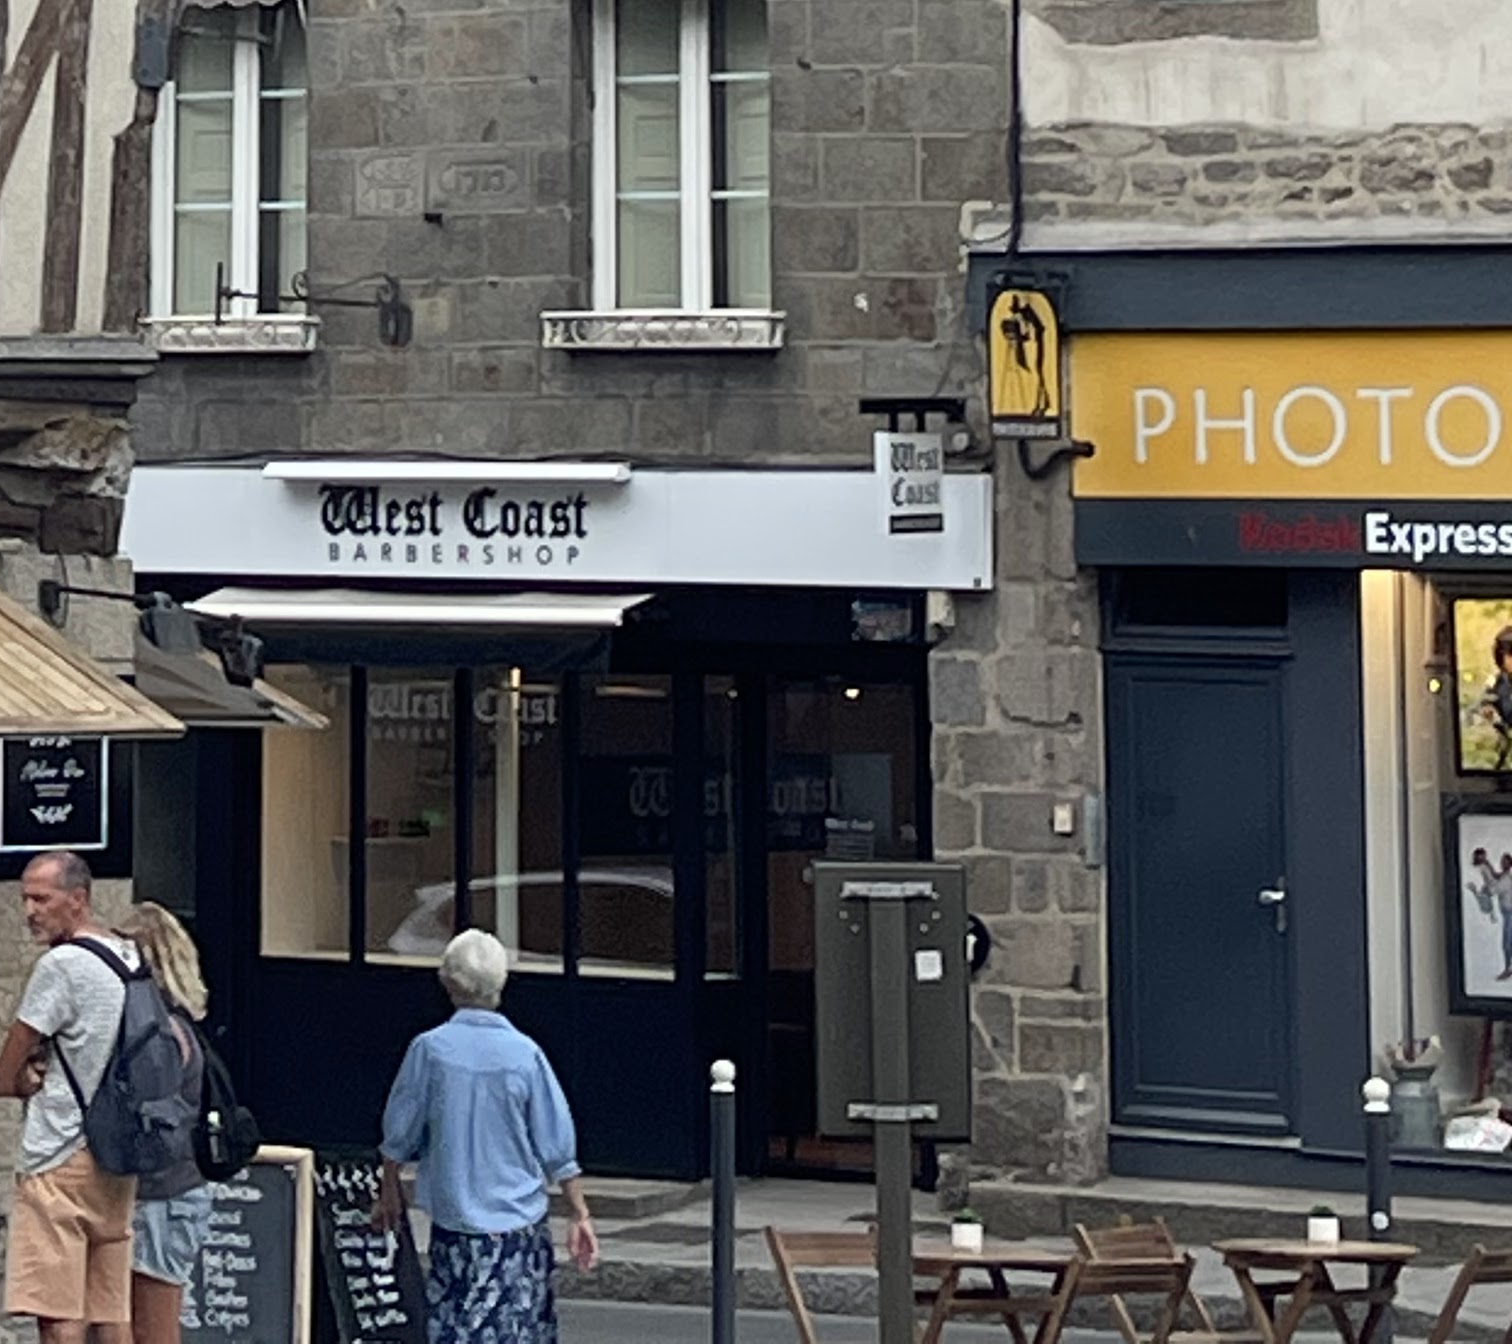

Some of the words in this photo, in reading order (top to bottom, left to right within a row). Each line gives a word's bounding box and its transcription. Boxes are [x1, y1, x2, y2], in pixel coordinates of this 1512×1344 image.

[1133, 384, 1502, 468] PHOTO
[318, 482, 444, 537] West
[462, 485, 590, 539] Coast
[1365, 511, 1512, 563] Express
[328, 542, 580, 566] BARBERSHOP
